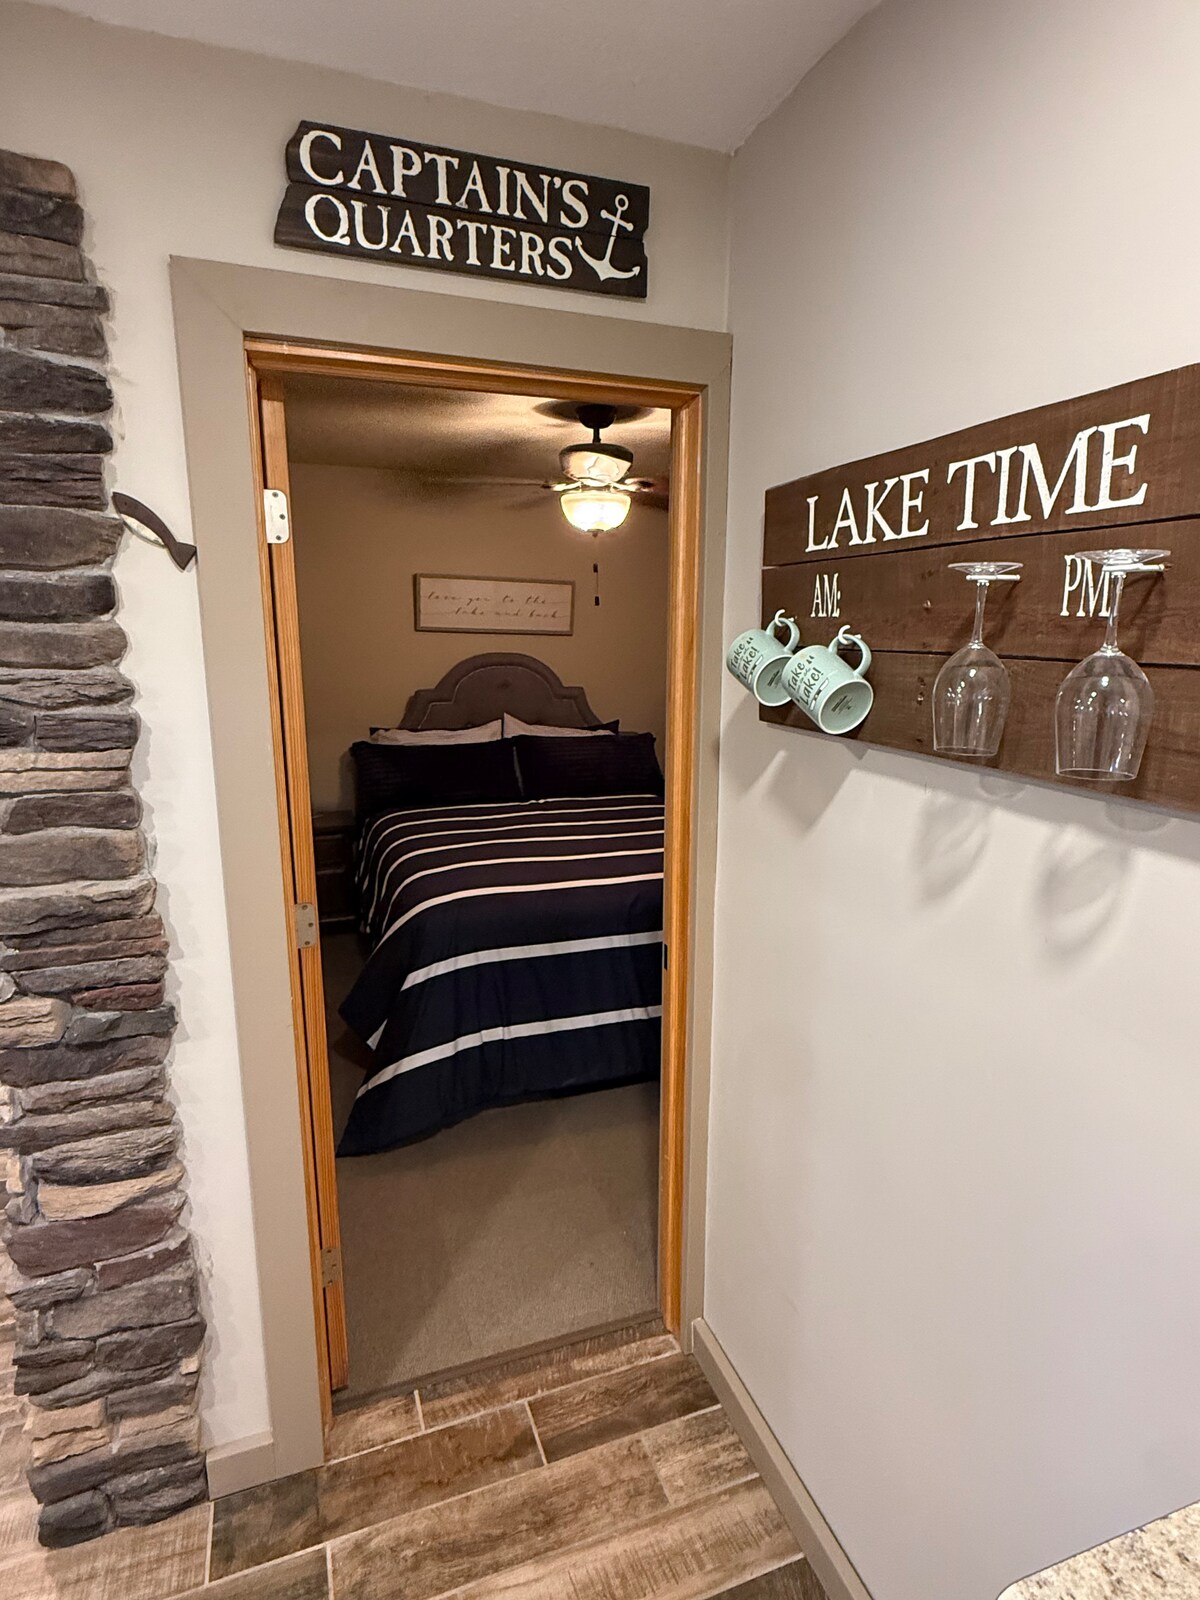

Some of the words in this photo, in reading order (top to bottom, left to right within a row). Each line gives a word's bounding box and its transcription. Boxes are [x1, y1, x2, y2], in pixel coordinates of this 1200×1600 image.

[300, 130, 589, 228] CAPTAIN'S
[304, 194, 573, 280] QUARTERS
[805, 468, 930, 552] LAKE
[947, 414, 1150, 531] TIME
[788, 662, 806, 691] Take
